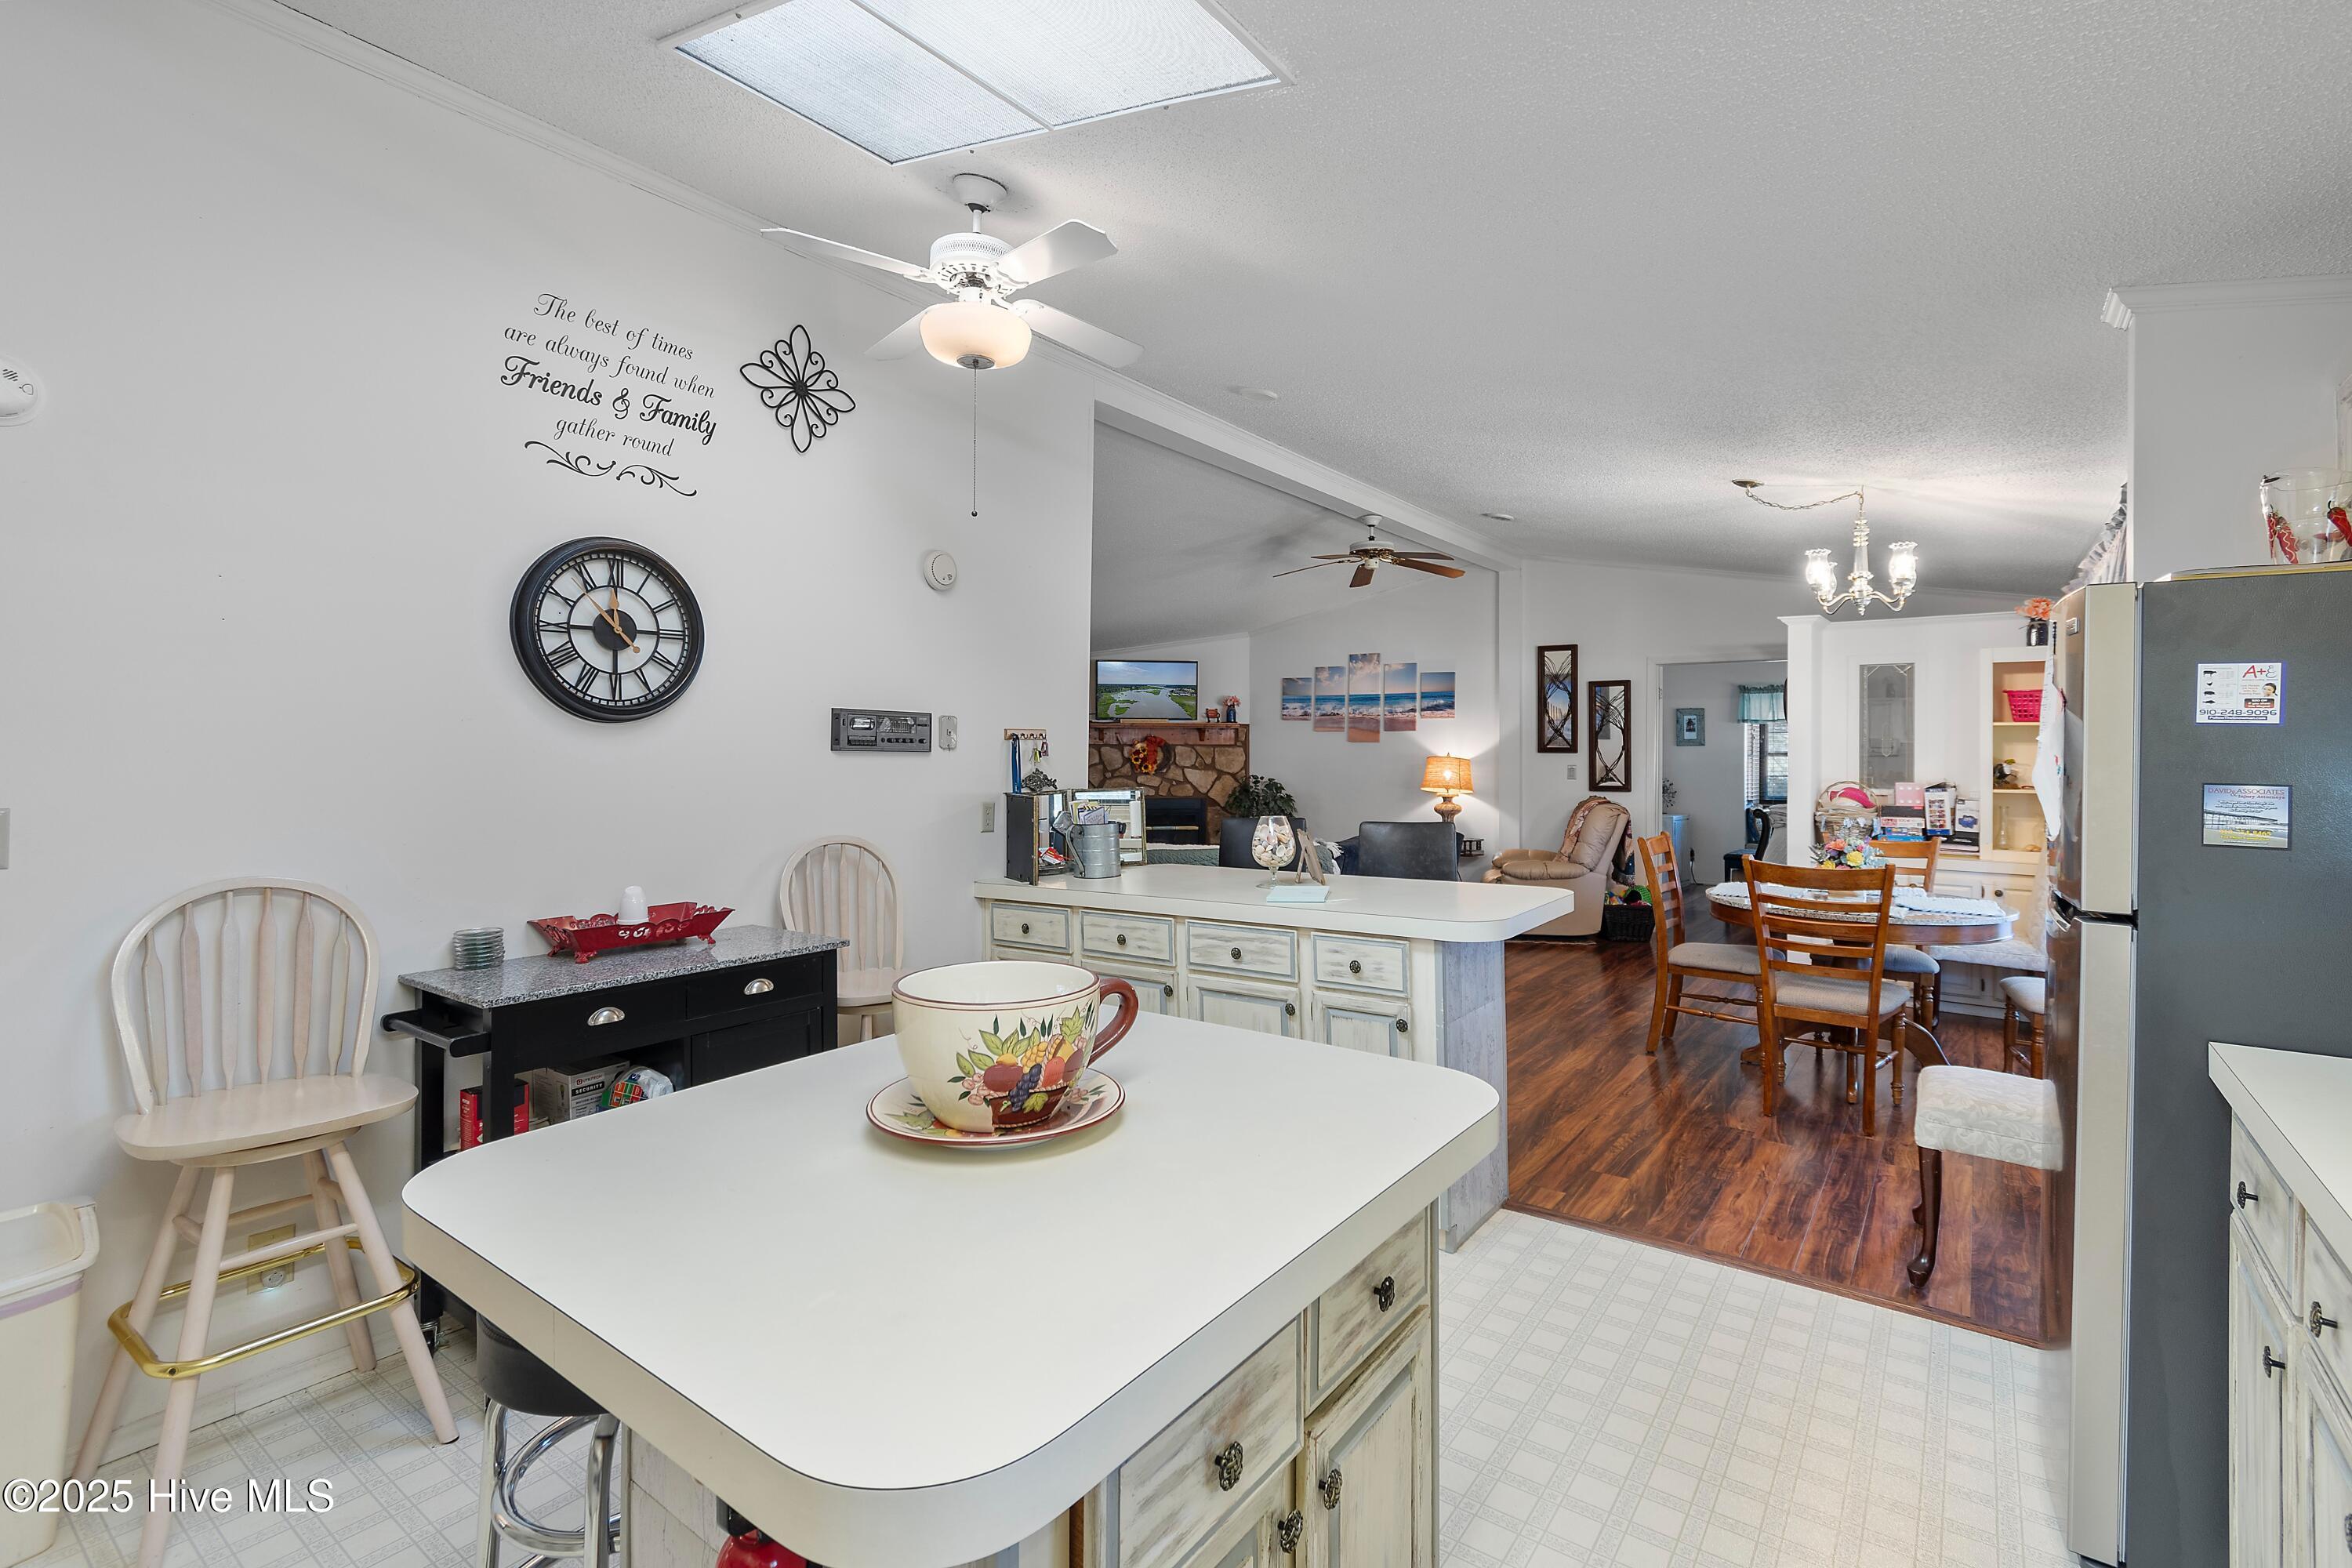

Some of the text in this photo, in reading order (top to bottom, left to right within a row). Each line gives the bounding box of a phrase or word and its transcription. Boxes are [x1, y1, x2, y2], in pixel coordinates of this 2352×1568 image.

[533, 293, 693, 360] The best of times
[504, 327, 714, 398] are always found when
[500, 356, 717, 445] Friends & Family
[554, 418, 674, 456] gather round
[575, 1083, 603, 1094] SECURITY
